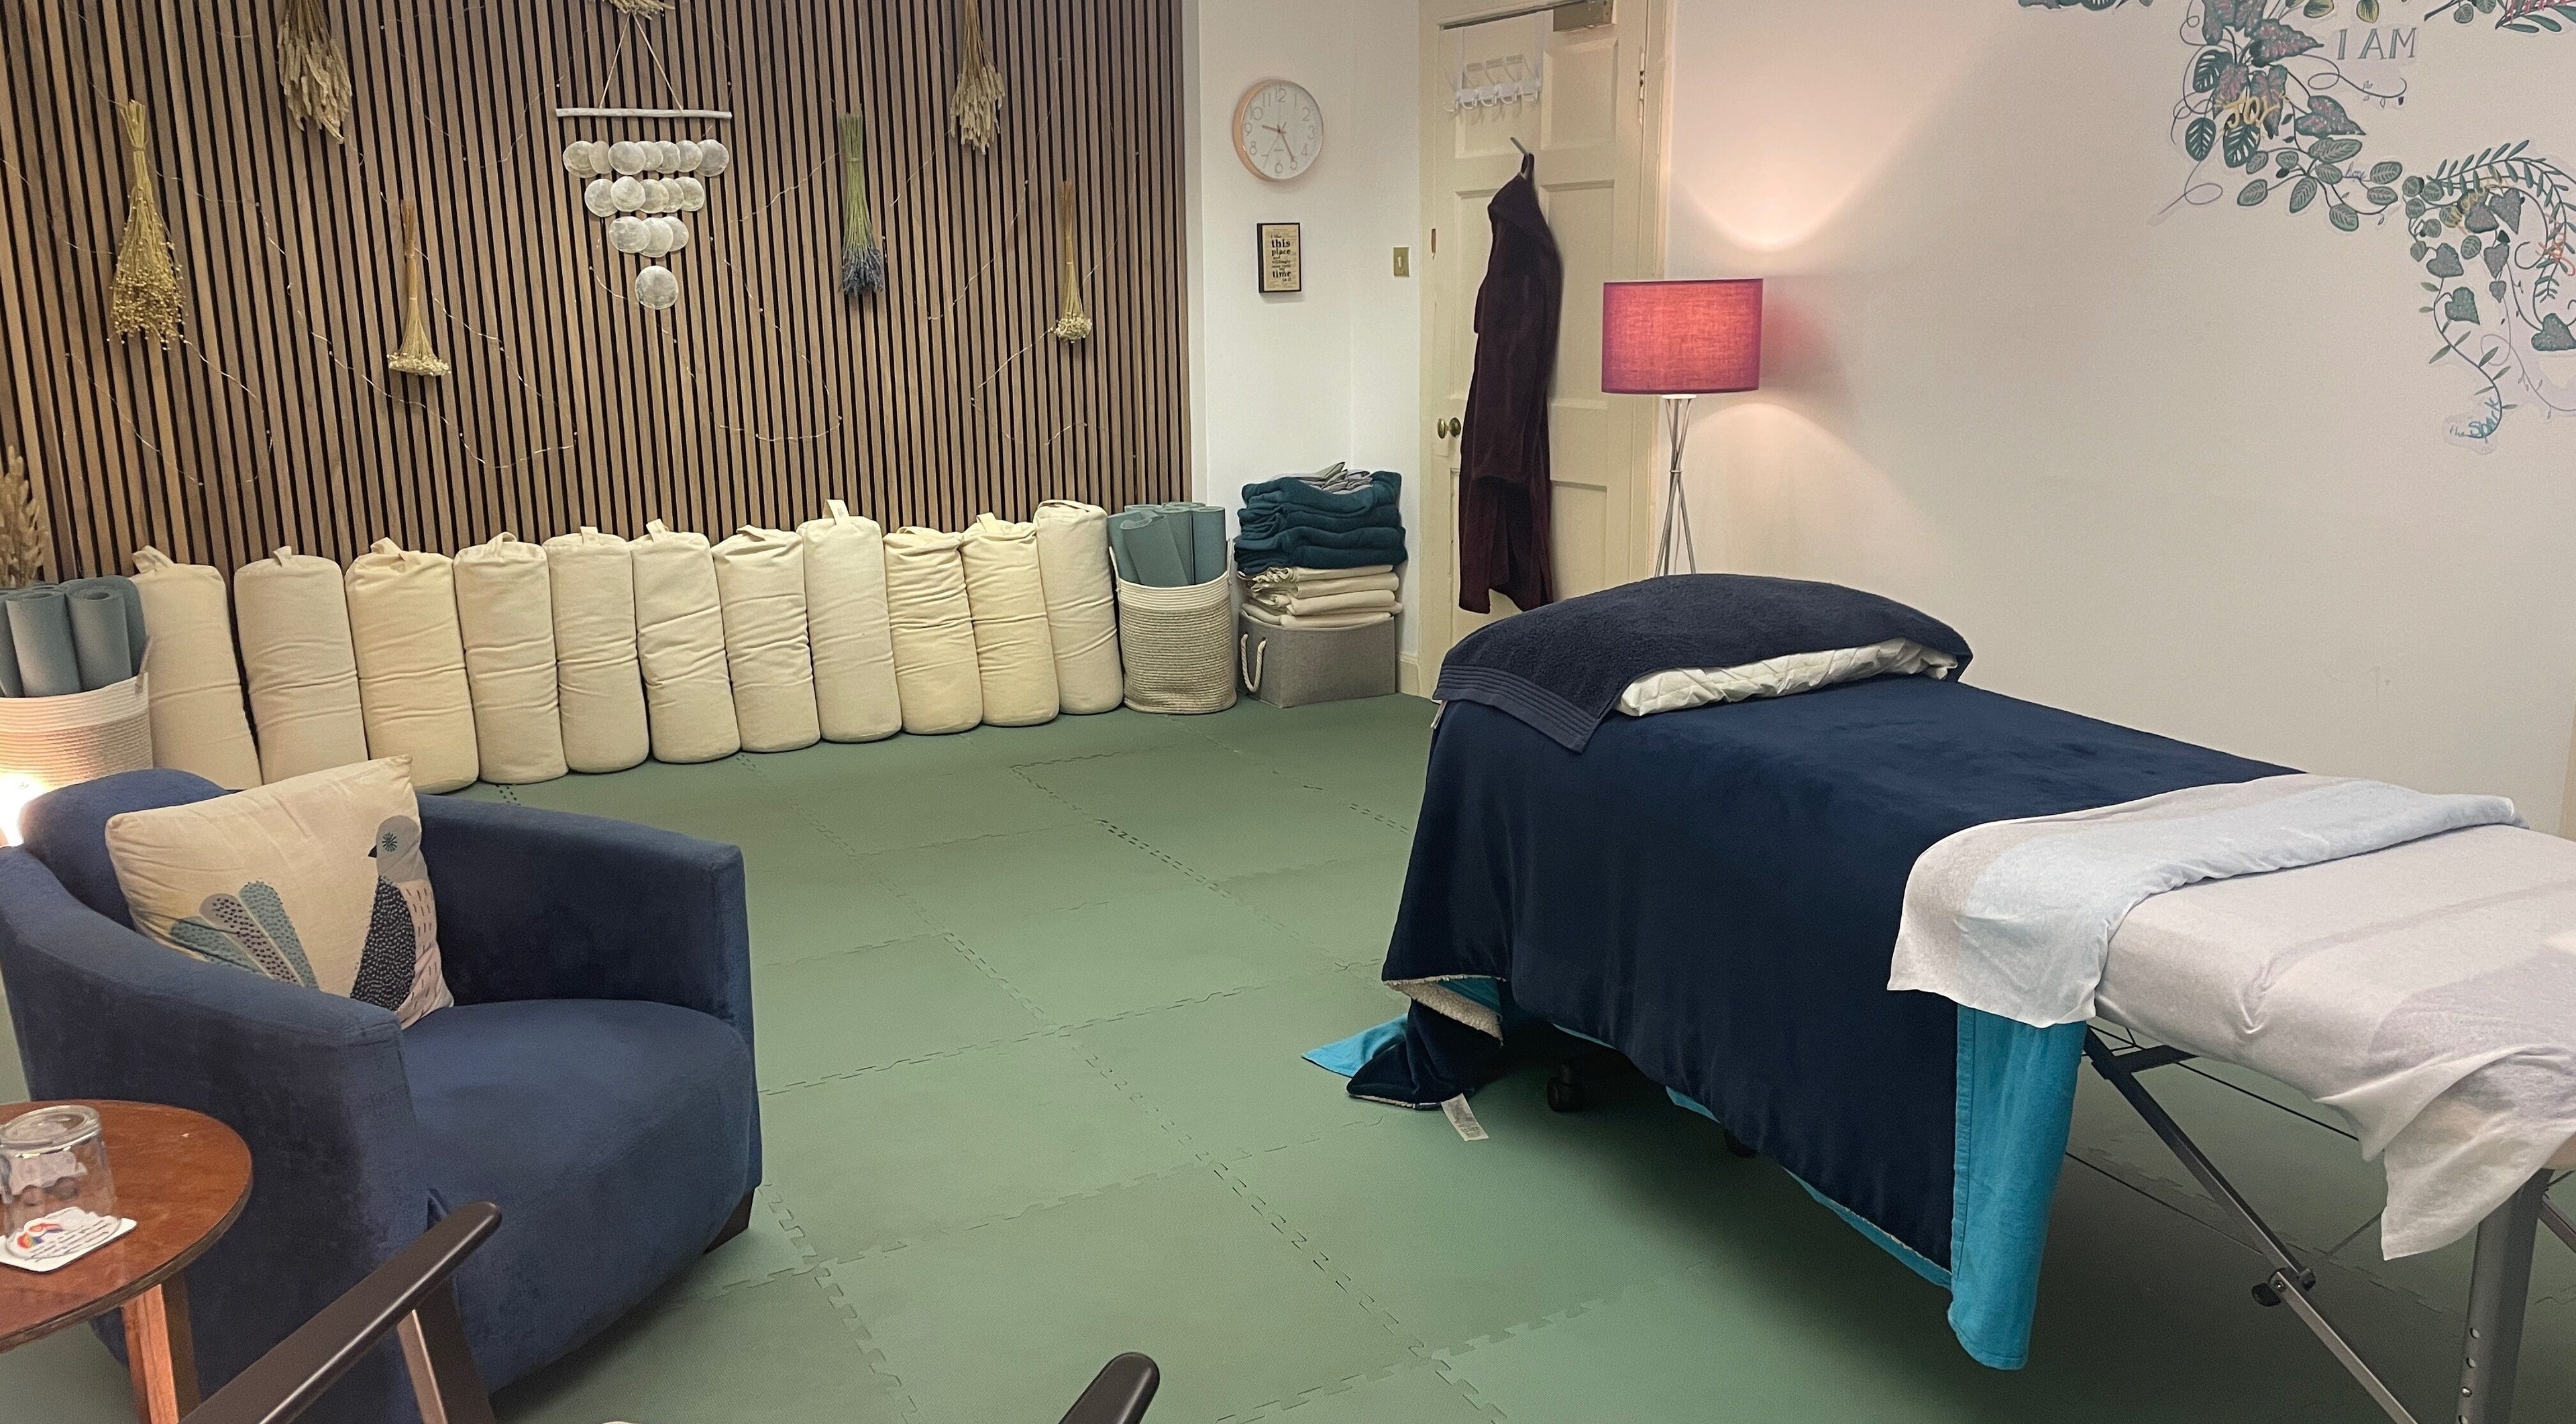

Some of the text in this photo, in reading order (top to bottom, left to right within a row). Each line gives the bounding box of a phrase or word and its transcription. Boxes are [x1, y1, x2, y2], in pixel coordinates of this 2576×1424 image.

[2337, 28, 2416, 60] I AM
[1263, 93, 1271, 107] 11
[1276, 87, 1287, 103] 12
[1249, 105, 1263, 121] 10
[1302, 107, 1311, 121] 2
[1244, 122, 1252, 137] 9
[1307, 125, 1316, 140] 3
[1249, 140, 1257, 156] 8
[1300, 143, 1308, 156] 4
[1275, 159, 1283, 174] 6
[1271, 239, 1290, 248] this
[1271, 248, 1291, 256] place
